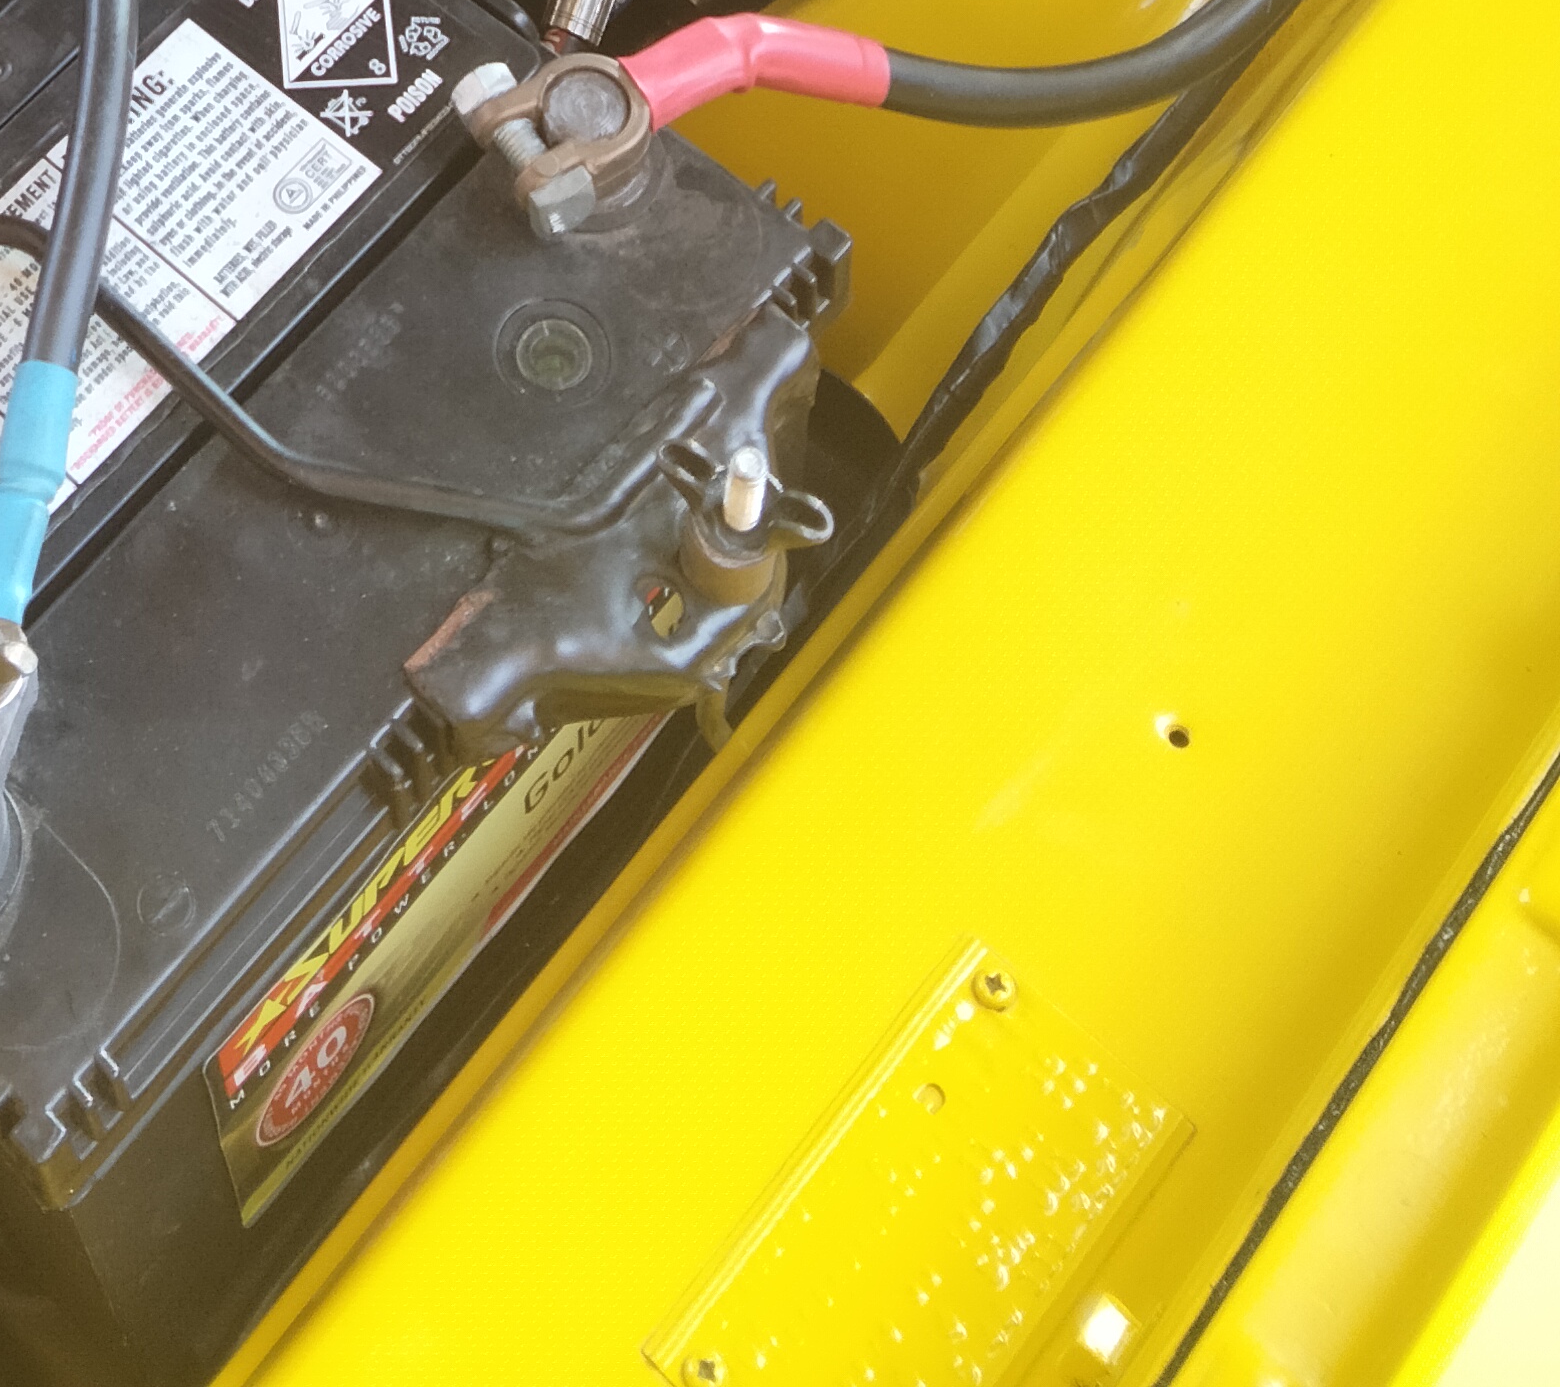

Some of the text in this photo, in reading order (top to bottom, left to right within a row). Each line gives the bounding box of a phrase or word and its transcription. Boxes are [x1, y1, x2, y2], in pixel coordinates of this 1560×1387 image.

[308, 5, 382, 79] CORROSIVE
[366, 54, 388, 78] 8
[154, 82, 191, 119] generate
[185, 49, 223, 87] explosive
[159, 110, 182, 134] from
[205, 59, 235, 89] flames
[190, 99, 215, 125] When
[211, 67, 248, 105] charging
[385, 65, 444, 125] POISON
[130, 178, 158, 206] using
[153, 148, 187, 183] battery
[193, 103, 232, 143] enclosed
[132, 86, 271, 227] provide ventilation. This battery contains
[144, 198, 184, 238] sulphuric
[198, 158, 223, 183] Avoid
[219, 130, 251, 163] contact
[246, 114, 267, 135] with
[262, 95, 285, 119] skin,
[169, 231, 195, 258] flush
[190, 212, 214, 236] with
[211, 189, 238, 215] water
[234, 171, 255, 192] and
[268, 116, 311, 159] physician
[221, 165, 238, 183] the
[233, 146, 257, 170] event
[303, 149, 333, 180] CERT
[326, 163, 368, 205] PHILIPPINES
[181, 212, 238, 269] immediately.
[13, 284, 35, 307] USE
[274, 763, 486, 1005] SUPER
[227, 999, 323, 1109] MORE
[276, 1023, 353, 1109] 40
